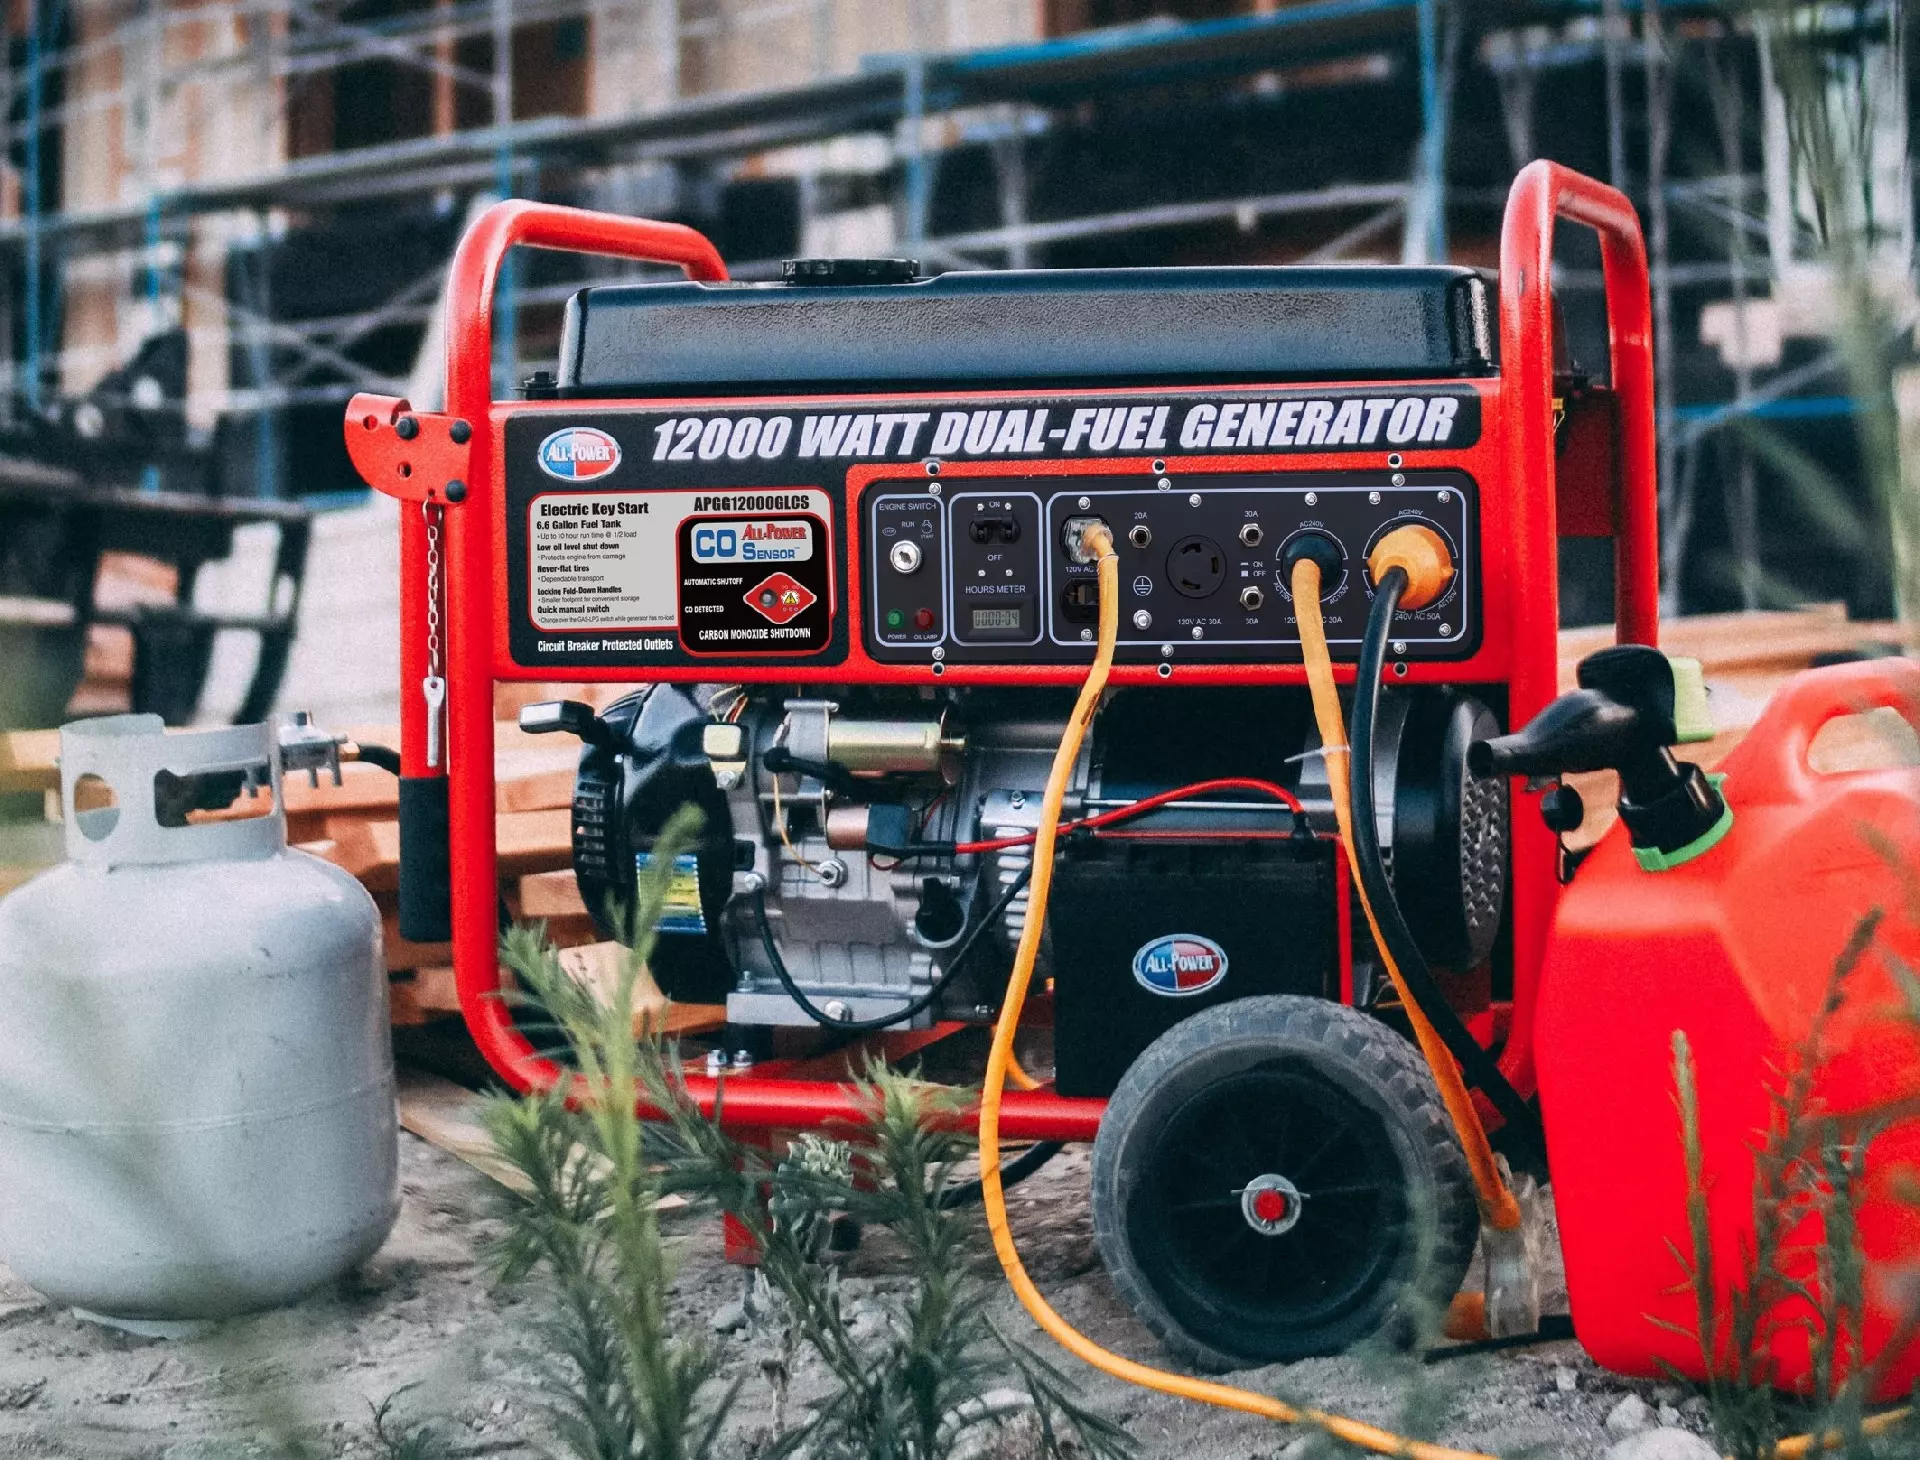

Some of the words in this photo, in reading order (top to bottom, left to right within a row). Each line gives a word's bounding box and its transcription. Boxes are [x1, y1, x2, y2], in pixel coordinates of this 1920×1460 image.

[652, 416, 793, 461] 12000
[798, 412, 931, 457] WATT
[930, 405, 1170, 455] DUAL-FUEL
[1179, 397, 1459, 448] GENERATOR
[546, 443, 611, 462] ALL-POWER
[694, 495, 810, 512] APGG12000GLCS
[878, 503, 906, 511] ENGINE
[908, 502, 936, 510] SWITCH
[540, 503, 589, 517] Electric
[592, 503, 616, 516] Key
[618, 502, 649, 514] Start
[536, 521, 550, 530] 6.6
[552, 520, 578, 530] Gallon
[581, 520, 598, 529] Fuel
[601, 520, 622, 528] Tank
[741, 524, 807, 540] ALL-POWER
[554, 543, 562, 551] oil
[564, 542, 580, 550] level
[582, 542, 598, 550] shut
[600, 542, 620, 550] down
[696, 529, 736, 558] CO
[742, 542, 796, 560] SENSOR
[537, 565, 572, 573] Never-flat
[574, 564, 590, 572] tires
[684, 578, 716, 586] AUTOMATIC
[717, 577, 744, 585] SHUTOFF
[596, 586, 622, 594] Handles
[966, 585, 995, 594] HOURS
[996, 585, 1026, 593] METER
[537, 605, 558, 614] Quick
[559, 605, 585, 614] manual
[586, 604, 610, 613] switch
[1328, 616, 1342, 624] 30A
[1395, 613, 1412, 621] 240V
[698, 630, 729, 640] CARBON
[730, 628, 769, 640] MONOXIDE
[770, 628, 811, 639] SHUTDOWN
[538, 640, 566, 652] Circuit
[568, 640, 600, 652] Breaker
[602, 639, 643, 651] Protected
[644, 638, 674, 651] Outlets
[1145, 951, 1214, 973] ALL-POWER
